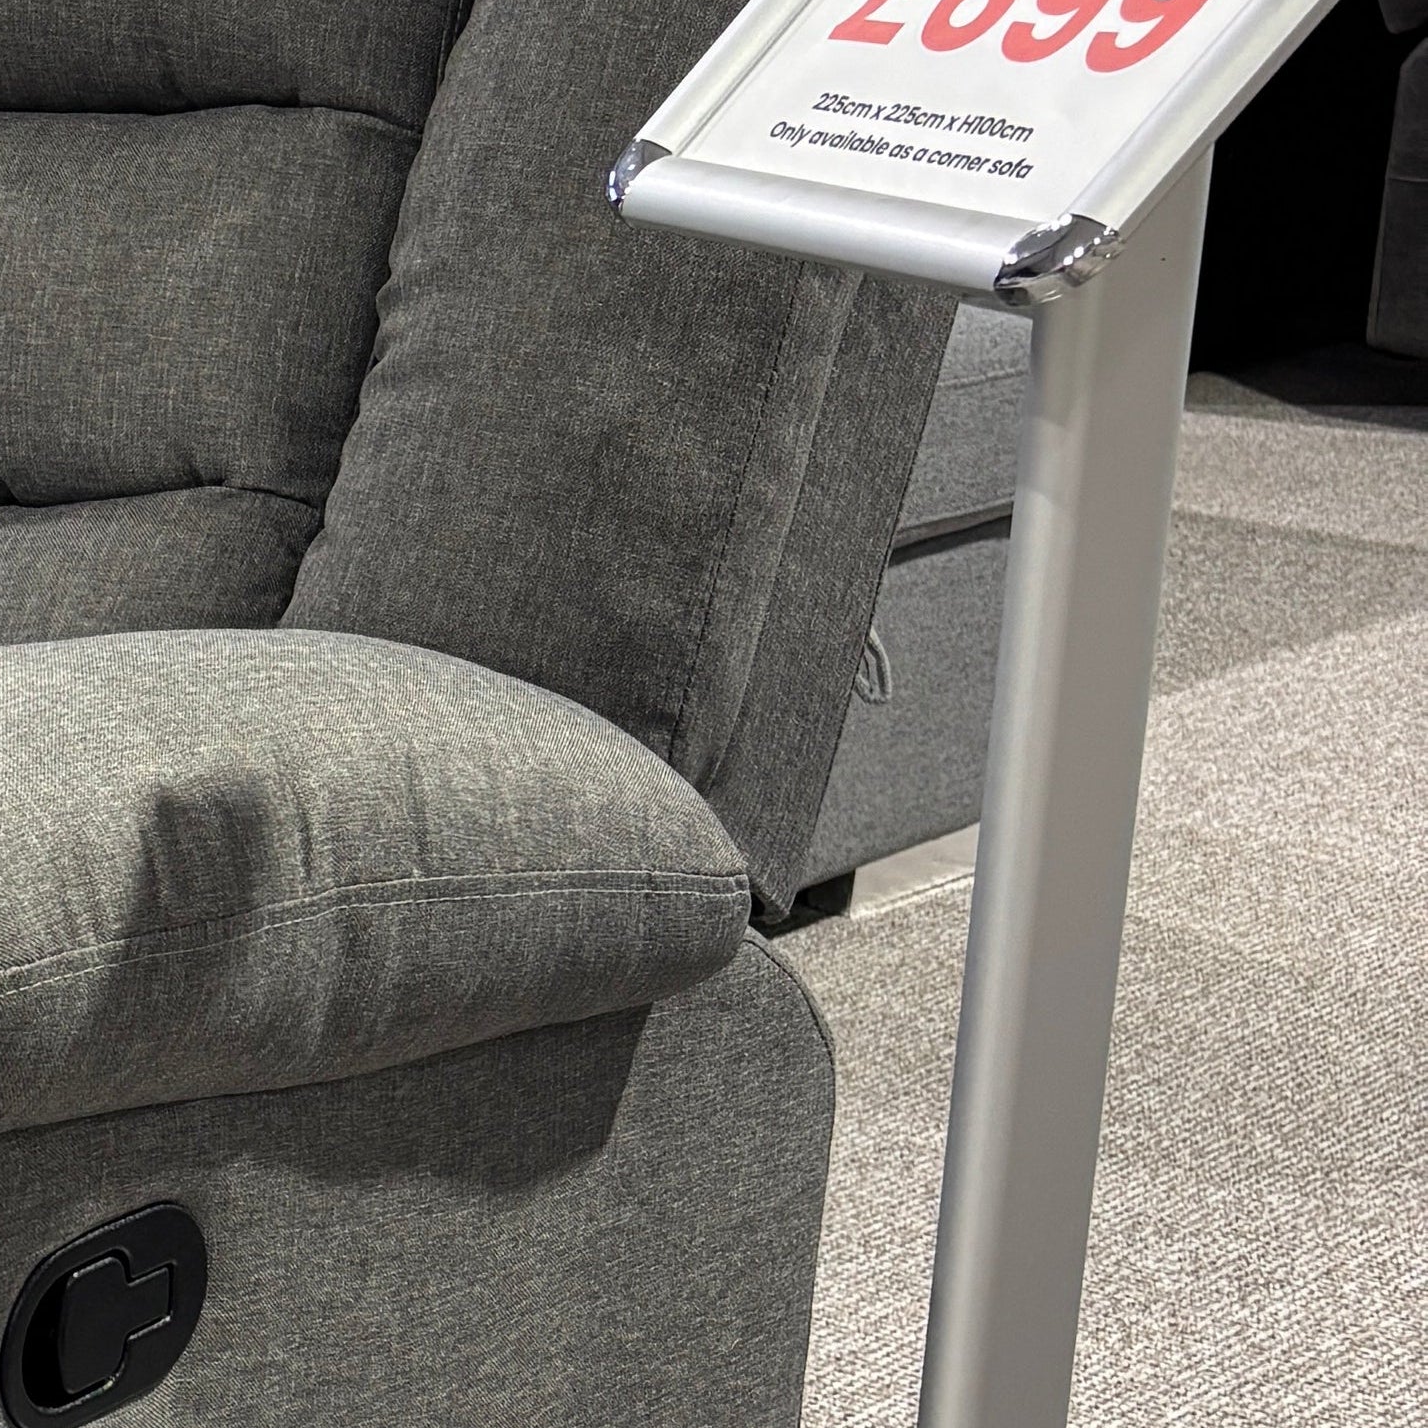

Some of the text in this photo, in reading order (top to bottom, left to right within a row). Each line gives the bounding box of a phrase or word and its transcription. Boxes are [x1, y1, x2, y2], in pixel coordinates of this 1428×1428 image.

[812, 93, 1034, 142] 225cm x 225cm x H100cm
[769, 121, 1034, 179] Only available as a corner sofa
